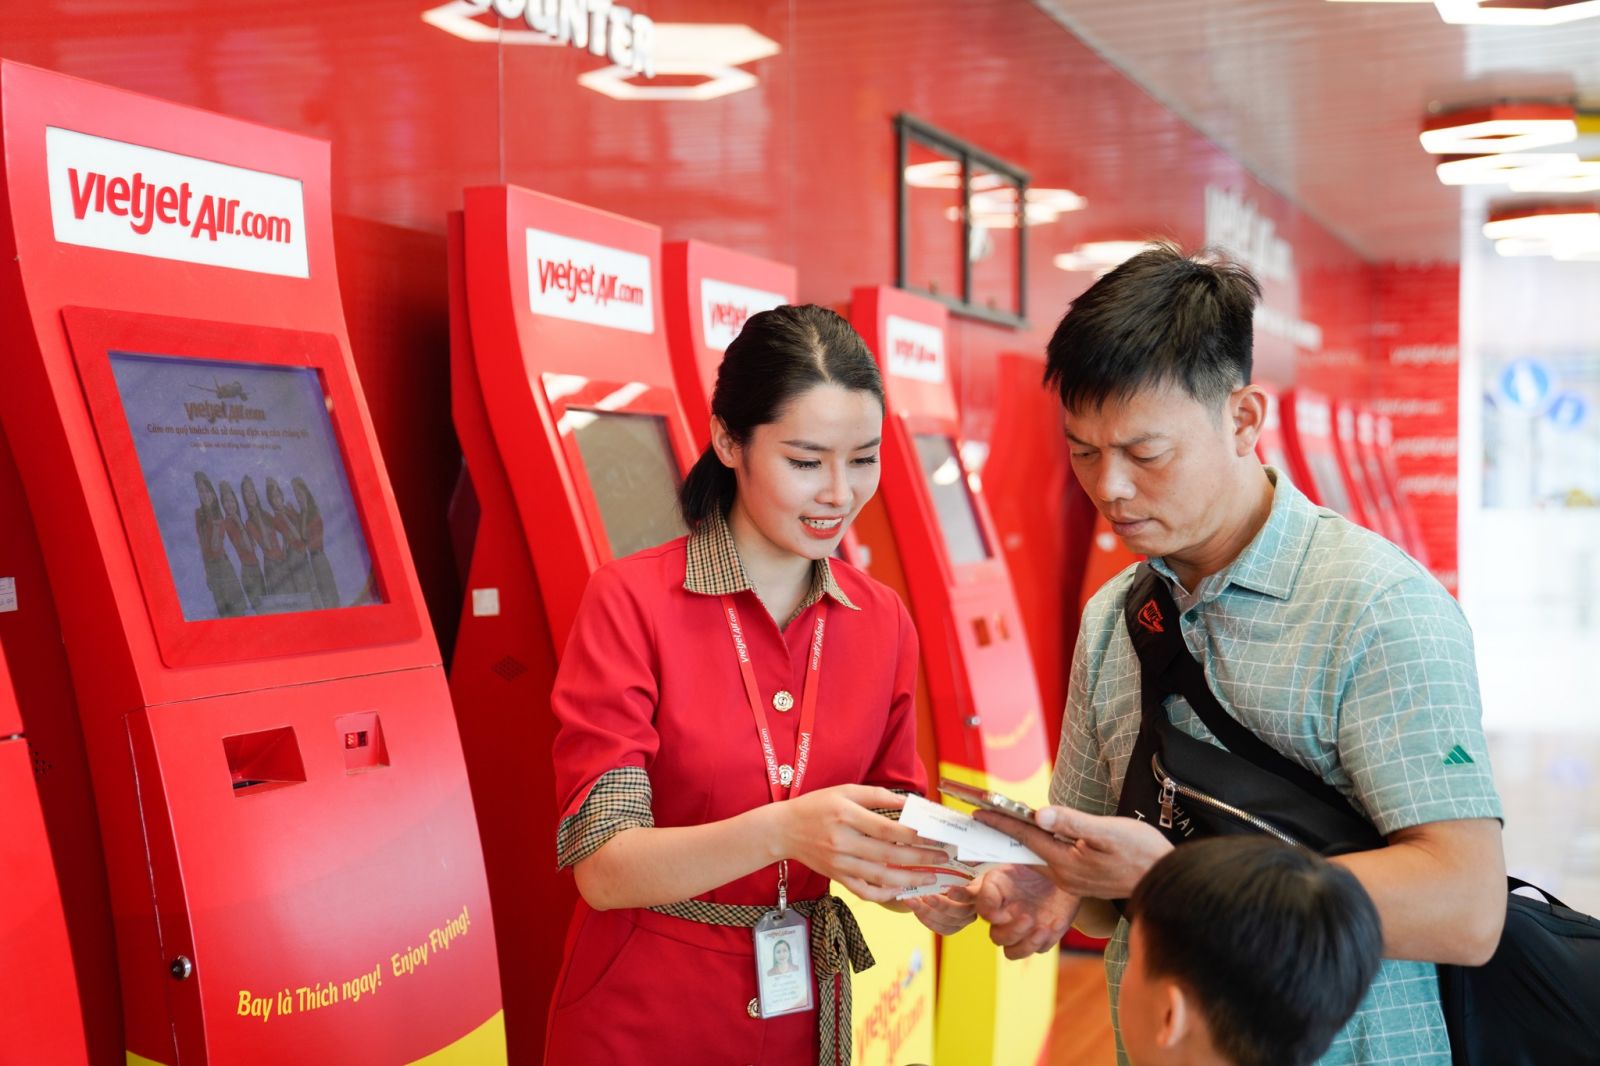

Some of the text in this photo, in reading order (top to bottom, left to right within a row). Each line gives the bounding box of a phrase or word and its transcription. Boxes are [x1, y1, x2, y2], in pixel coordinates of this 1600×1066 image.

[237, 905, 471, 1023] Bay là Thích ngay! Enjoy Flying!
